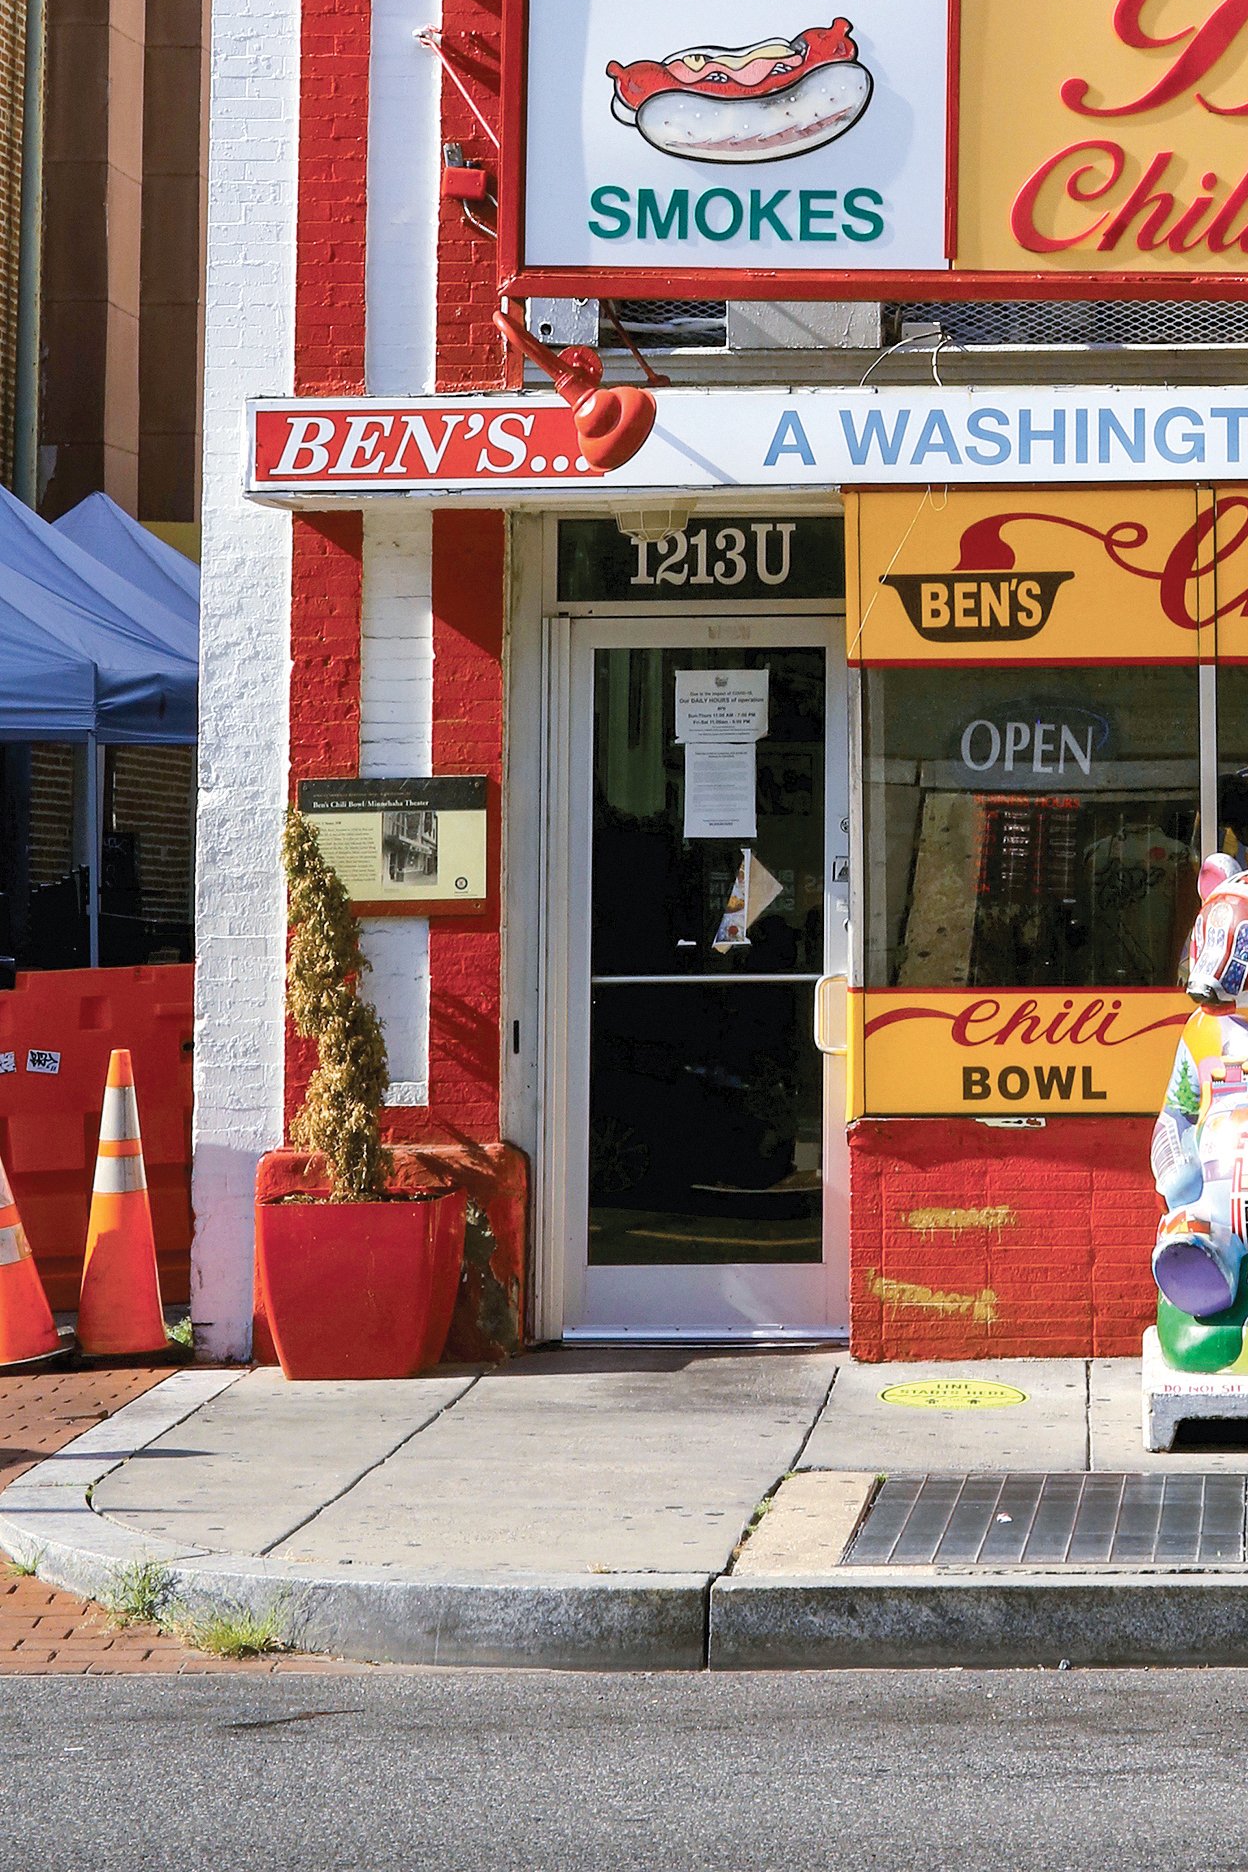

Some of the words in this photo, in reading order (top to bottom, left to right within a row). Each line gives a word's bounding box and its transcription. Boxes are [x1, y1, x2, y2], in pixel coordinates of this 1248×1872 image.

[587, 185, 886, 244] SMOKES
[763, 410, 817, 466] A
[921, 577, 1044, 628] BEN'S
[961, 719, 1093, 776] OPEN
[951, 997, 1126, 1047] Chili
[962, 1065, 1108, 1101] BOWL
[1163, 1383, 1182, 1393] DO
